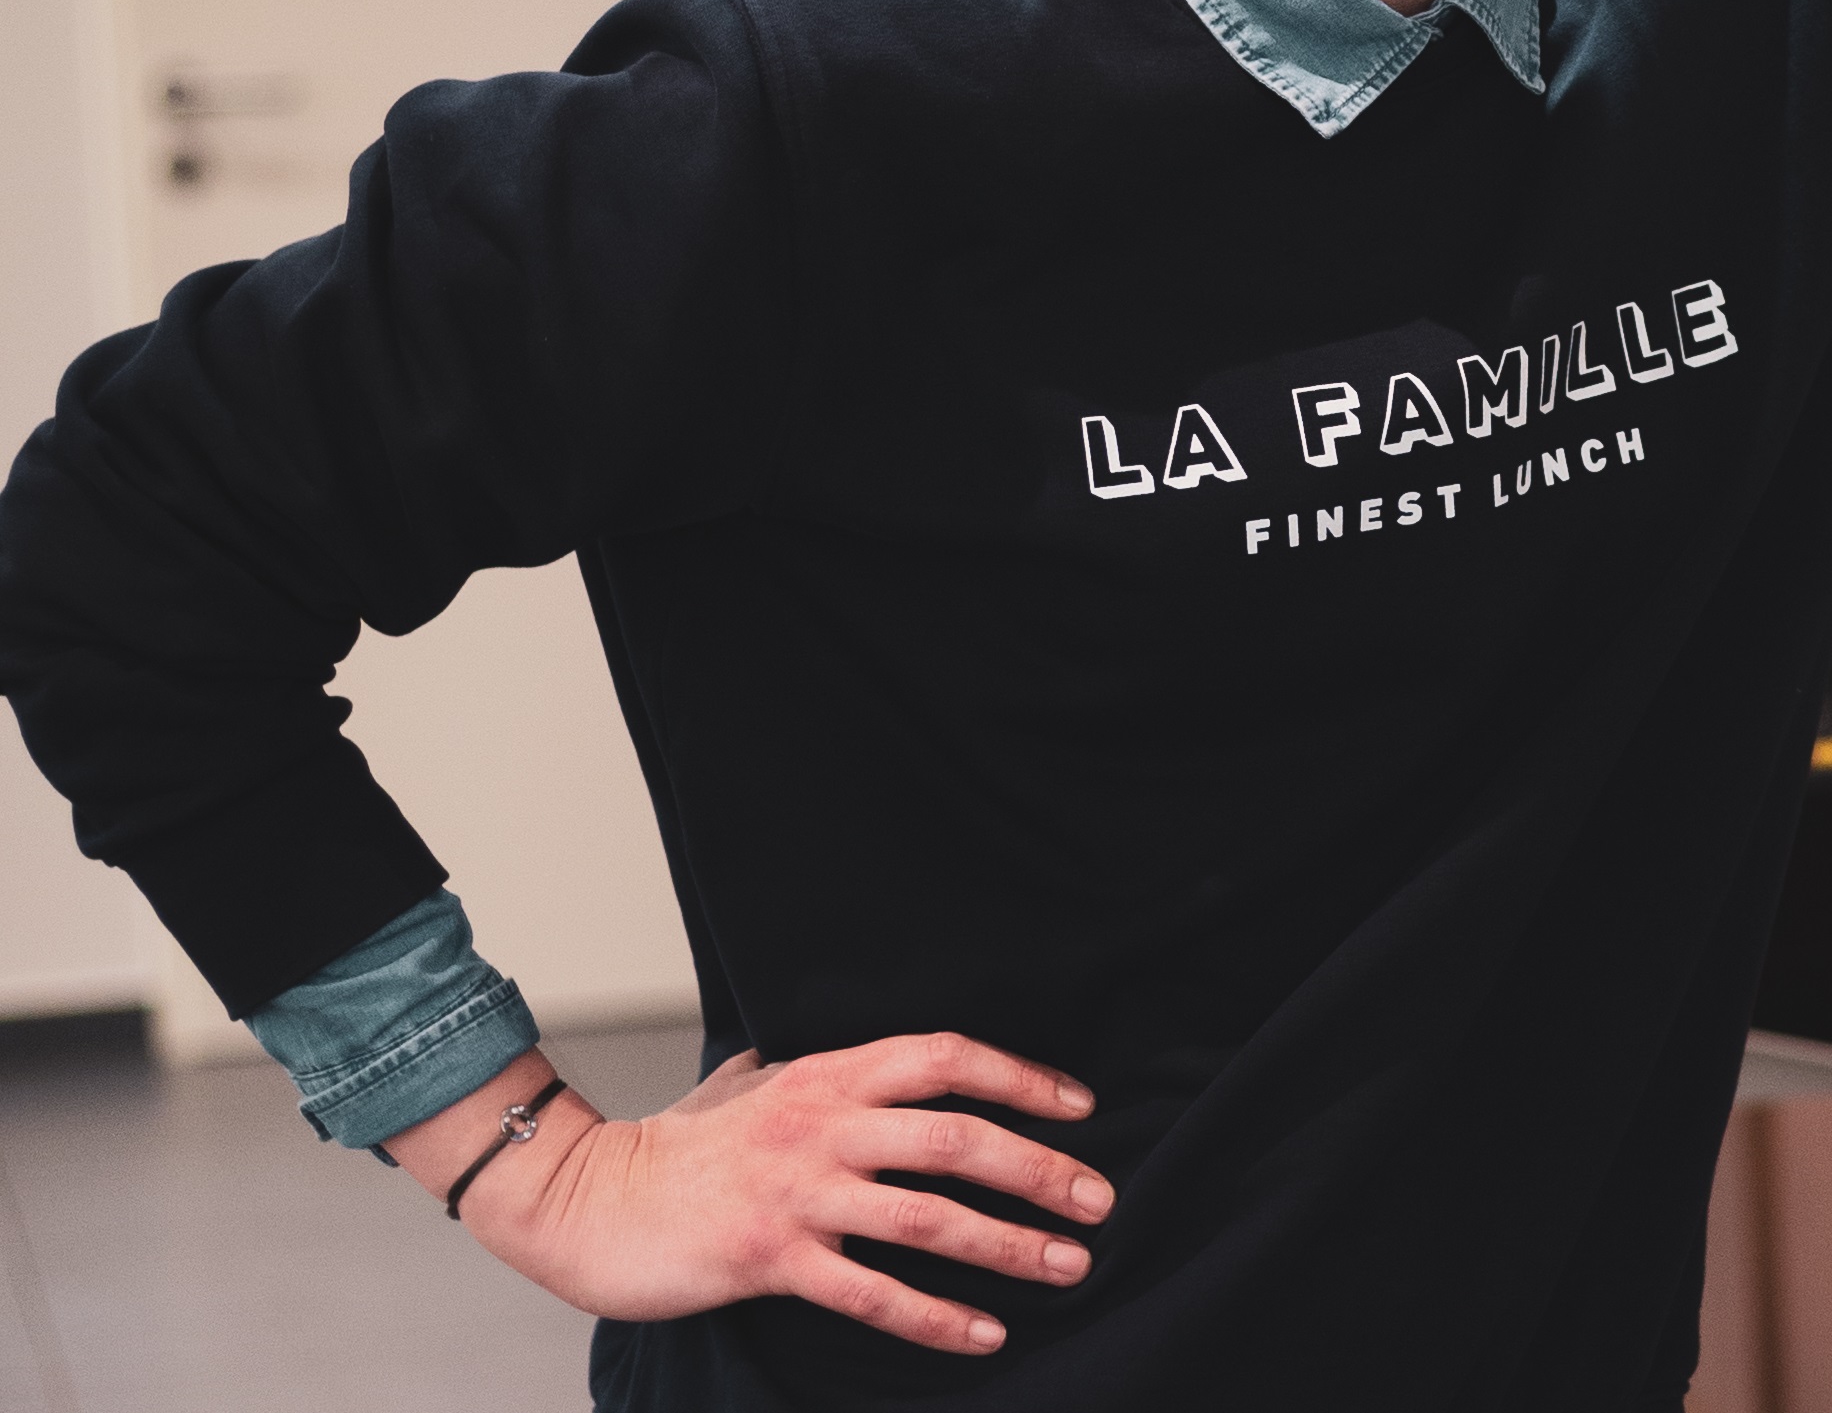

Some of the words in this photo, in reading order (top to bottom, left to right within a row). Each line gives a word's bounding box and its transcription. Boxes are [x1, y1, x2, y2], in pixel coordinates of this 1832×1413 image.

[1081, 404, 1248, 499] LA
[1292, 280, 1738, 468] FAMILLE
[1246, 484, 1461, 554] FINEST
[1491, 427, 1644, 507] LUNCH
